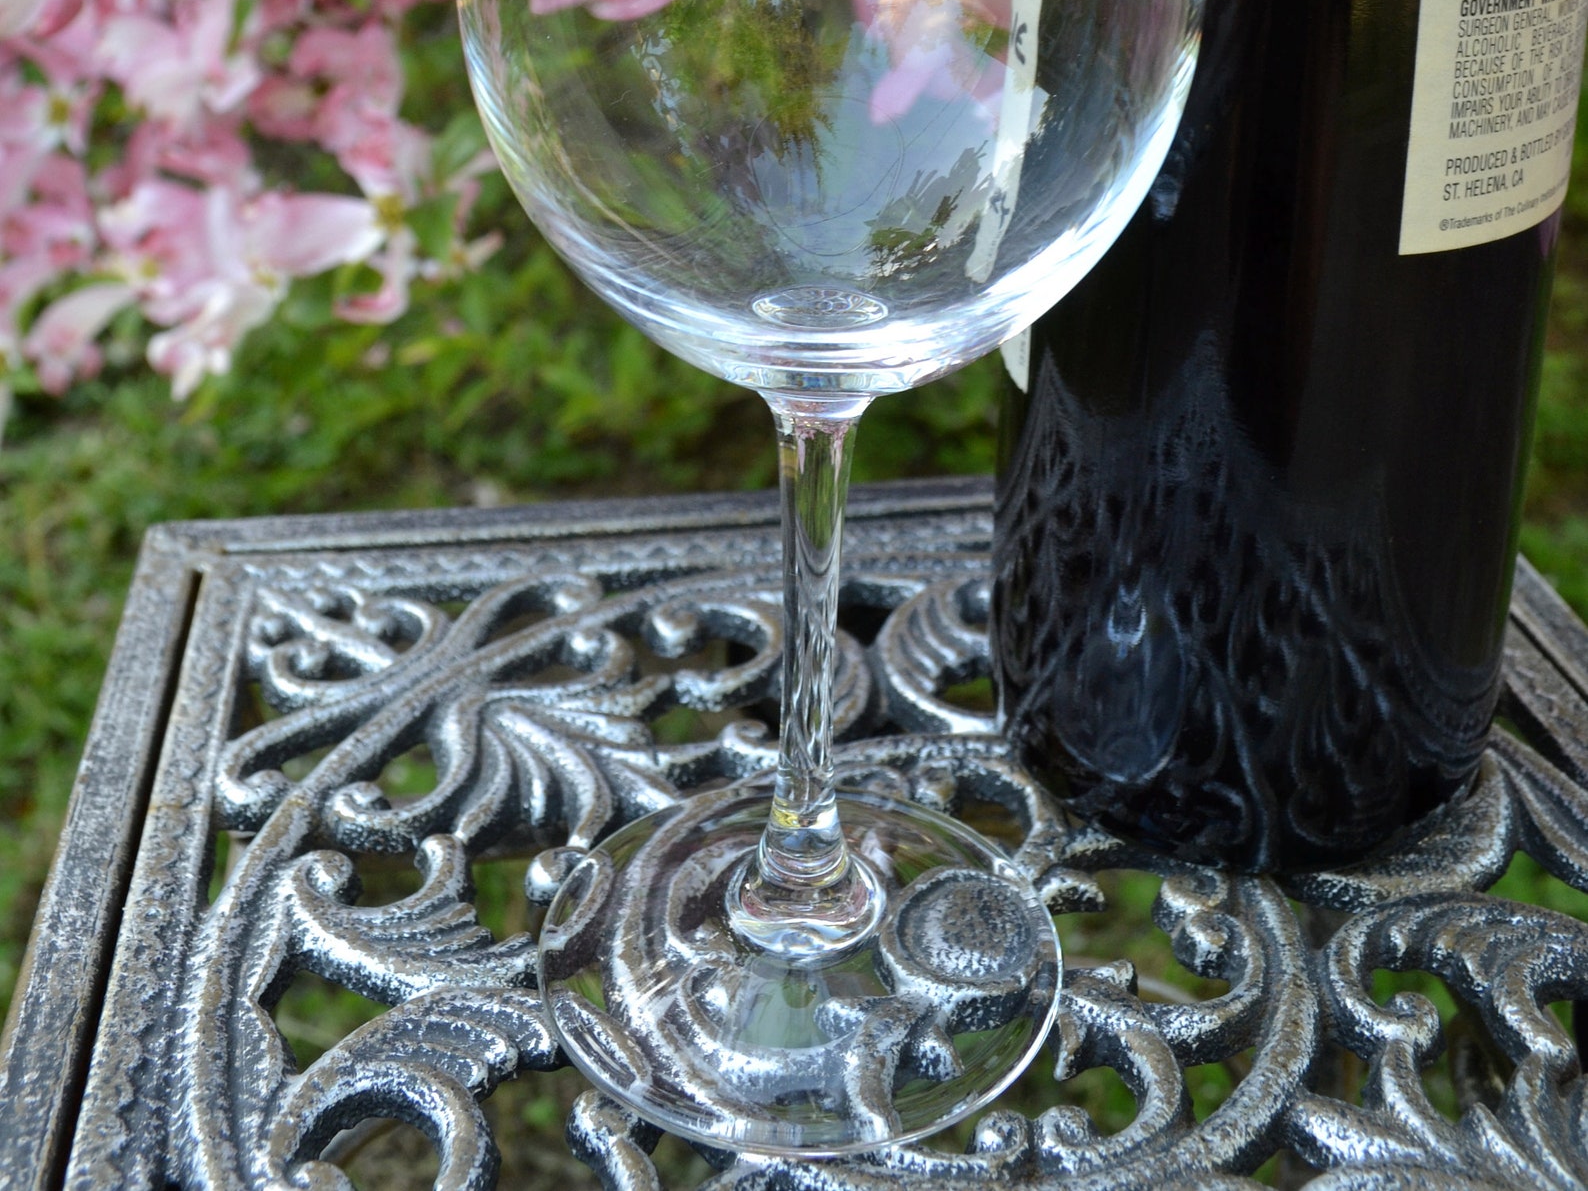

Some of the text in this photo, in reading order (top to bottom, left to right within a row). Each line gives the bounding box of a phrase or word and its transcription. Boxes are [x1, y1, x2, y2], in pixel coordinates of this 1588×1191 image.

[1458, 14, 1510, 38] SURGEON
[1455, 32, 1521, 59] ALCOHOLIC
[1454, 54, 1507, 79] BECAUSE
[1512, 51, 1525, 71] OF
[1529, 46, 1546, 66] THE
[1452, 69, 1534, 100] CONSUMPTION
[1450, 96, 1494, 120] IMPAIRS
[1499, 90, 1523, 113] YOUR
[1448, 112, 1513, 140] MACHINERY,
[1516, 106, 1534, 127] AND
[1445, 148, 1508, 176] PRODUCED
[1511, 147, 1518, 164] &
[1520, 132, 1554, 162] BOTTLED
[1443, 181, 1461, 202] ST.
[1512, 168, 1524, 188] CA
[1494, 208, 1502, 221] of
